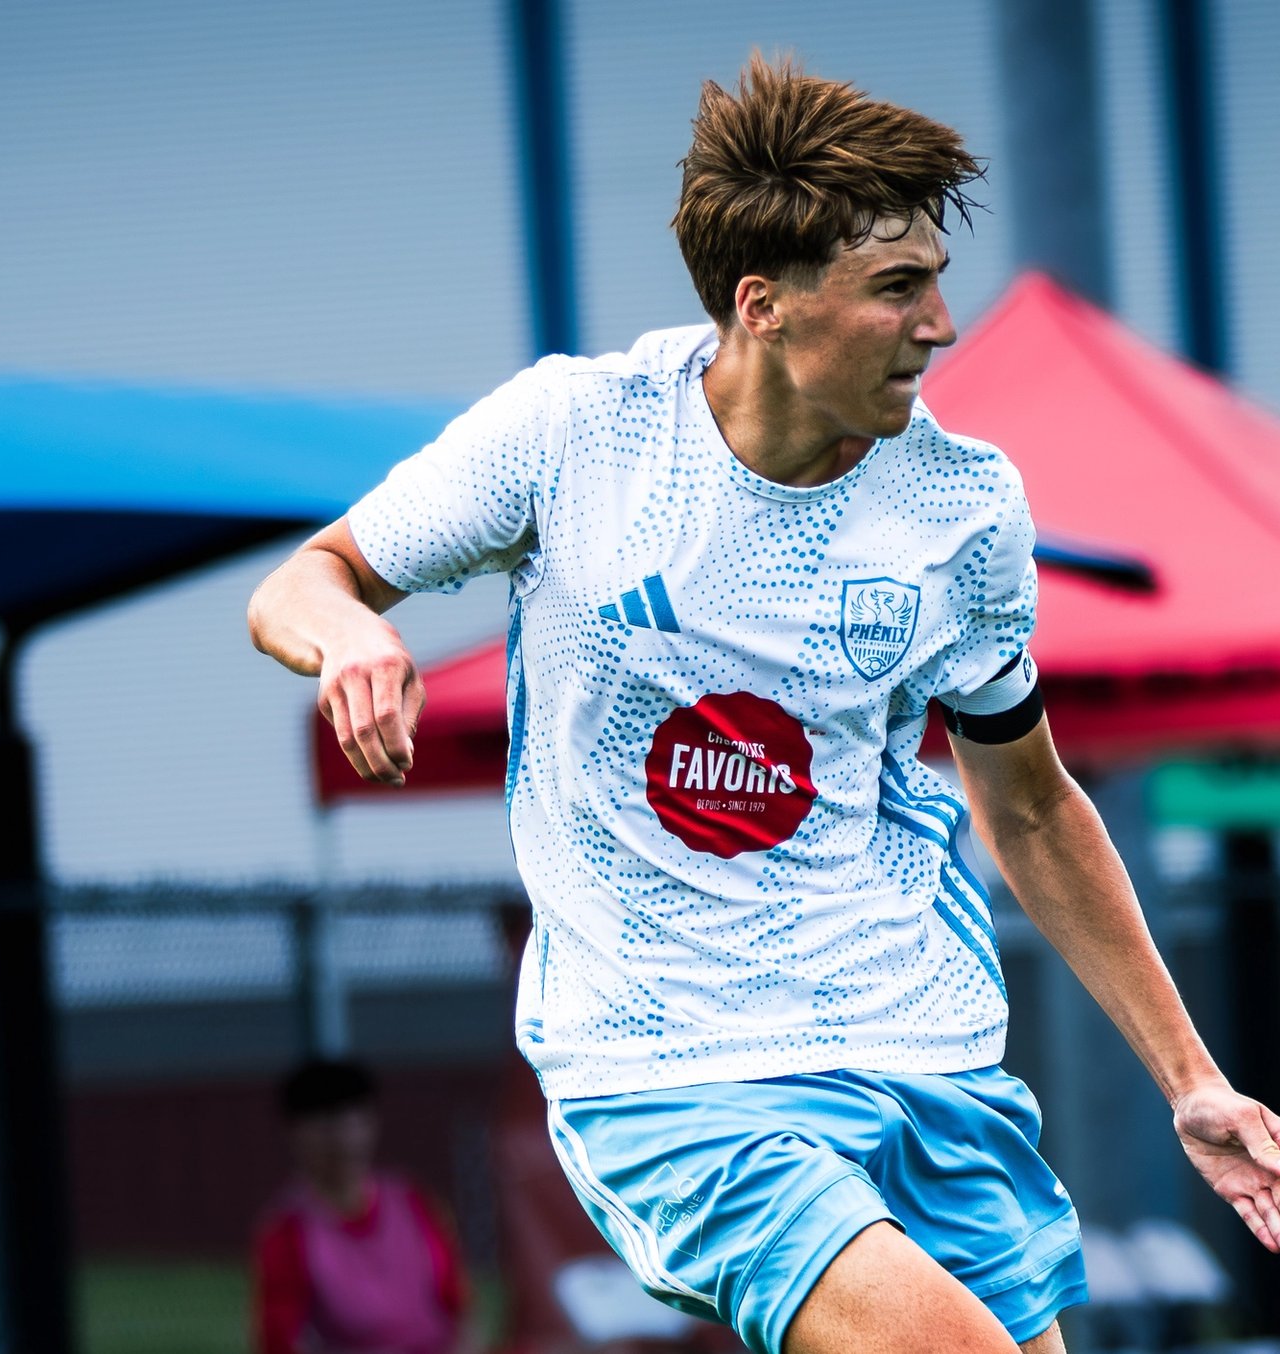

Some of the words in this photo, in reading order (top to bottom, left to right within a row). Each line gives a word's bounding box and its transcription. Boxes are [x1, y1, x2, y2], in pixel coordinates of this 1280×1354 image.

[847, 620, 908, 643] PHÉNIX
[668, 743, 797, 795] FAVORIS
[696, 799, 721, 811] DEPUIS
[727, 800, 747, 811] SINCE
[749, 801, 766, 813] 1979
